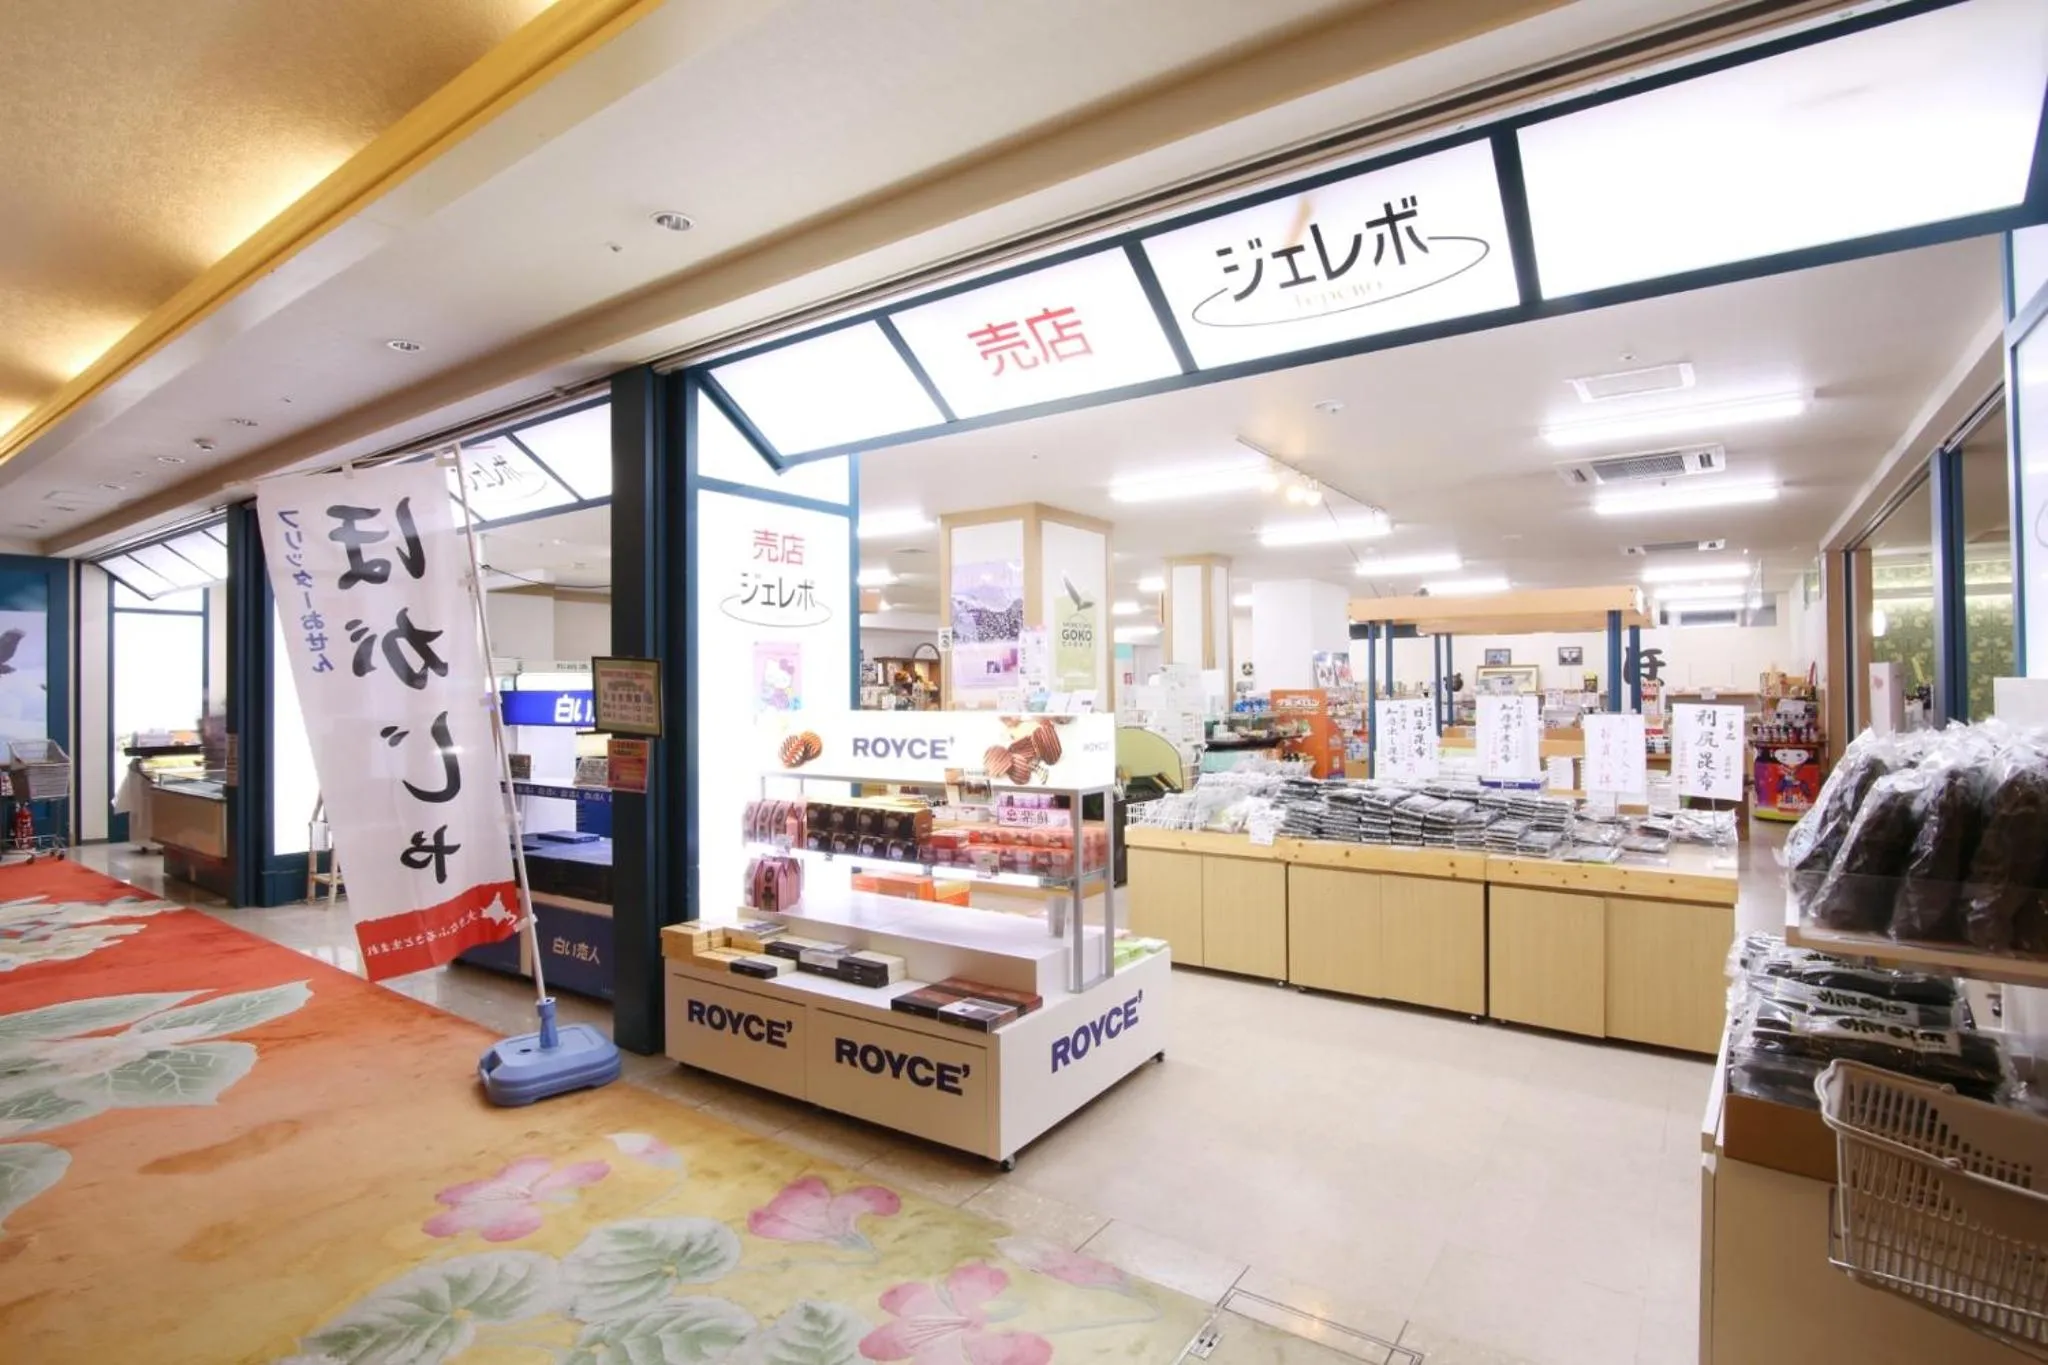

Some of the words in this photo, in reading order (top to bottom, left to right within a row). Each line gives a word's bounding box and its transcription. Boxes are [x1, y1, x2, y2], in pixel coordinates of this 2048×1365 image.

[1215, 195, 1429, 303] ジェレボ
[967, 306, 1094, 377] 売店
[753, 528, 805, 566] 売店
[741, 572, 816, 611] ジェレボ
[1061, 629, 1093, 641] GOKO
[554, 694, 596, 724] 白い
[1695, 709, 1720, 792] 利尻昆布
[552, 935, 602, 966] 白い恋人
